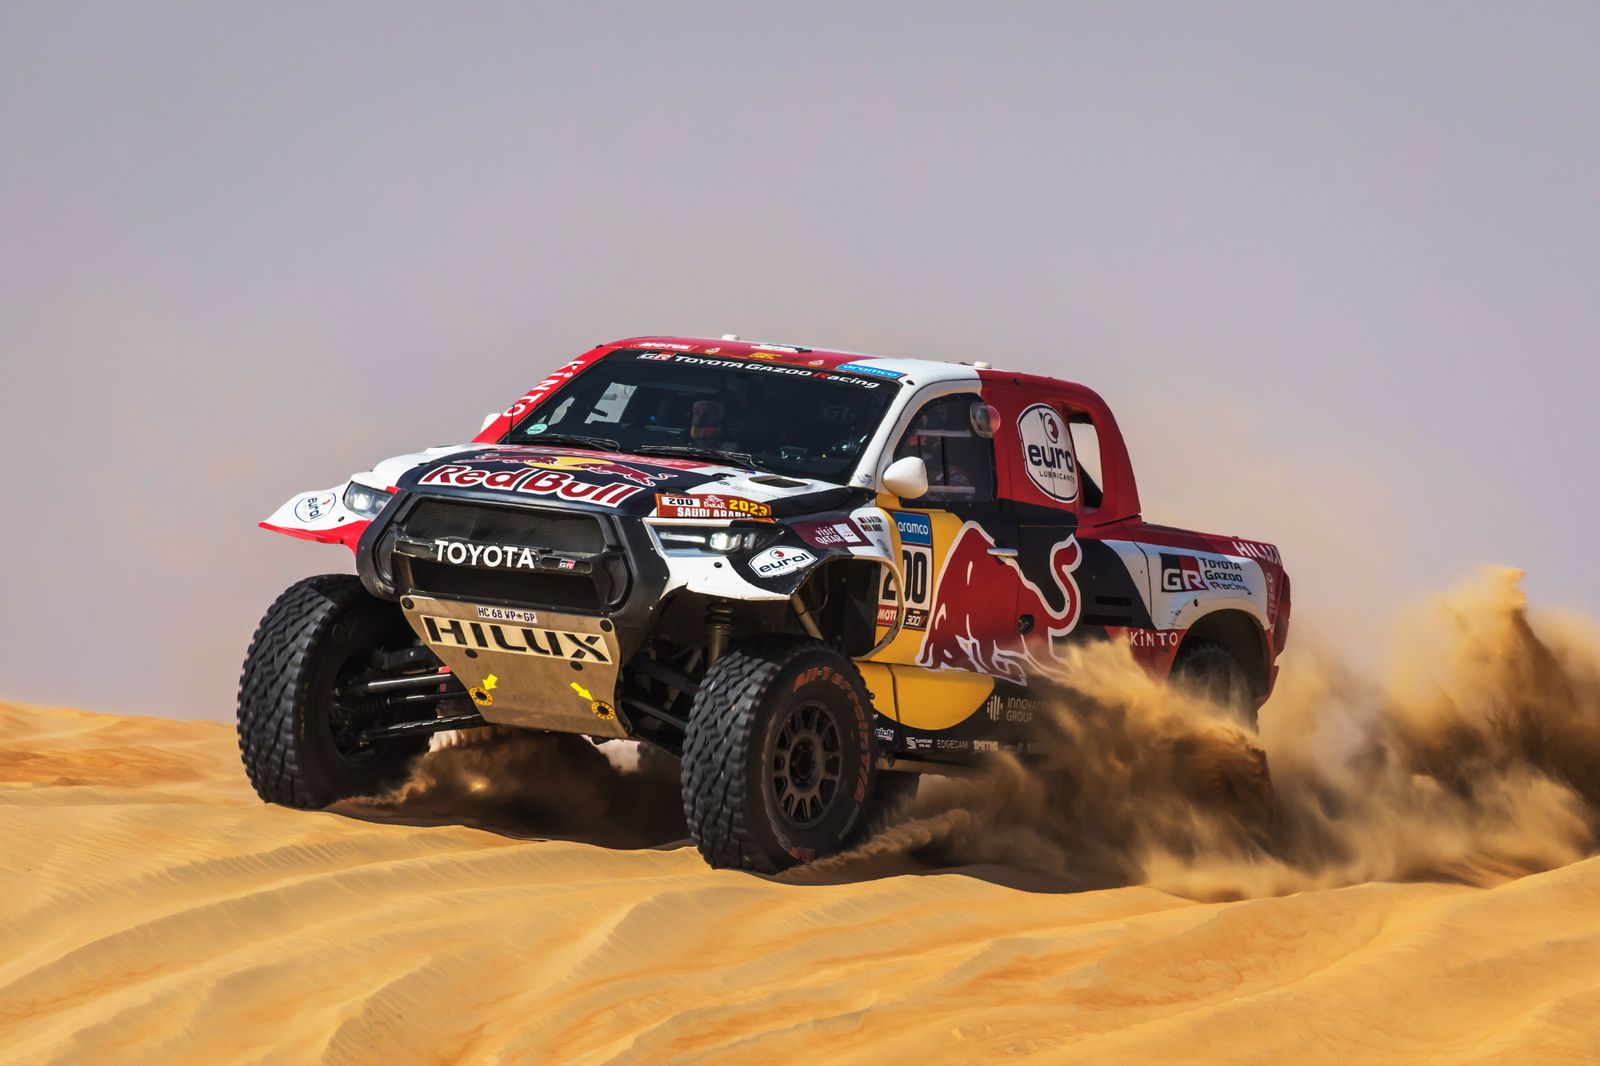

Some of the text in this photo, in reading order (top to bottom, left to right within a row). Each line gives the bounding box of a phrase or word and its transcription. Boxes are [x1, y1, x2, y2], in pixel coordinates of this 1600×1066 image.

[639, 352, 673, 360] GR
[675, 355, 744, 368] TOYOTA
[745, 363, 812, 376] GAZOO
[812, 372, 880, 389] Racing
[843, 364, 899, 377] aramco
[1028, 444, 1074, 473] euro
[421, 466, 644, 505] Red Bull
[308, 497, 323, 519] eurol
[668, 497, 694, 506] 200
[729, 499, 768, 516] 2023
[677, 507, 709, 517] SAUDI
[815, 526, 837, 537] visit
[898, 521, 929, 535] aramco
[815, 533, 844, 545] QATAR
[434, 540, 535, 569] TOYOTA
[1233, 541, 1283, 567] HILUX
[759, 553, 810, 573] eurol
[1201, 557, 1243, 571] TOYOTA
[1164, 568, 1206, 590] GR
[1204, 570, 1243, 583] GAZOO
[1211, 581, 1252, 595] Racing
[477, 607, 535, 622] HC 68 WP GP
[423, 617, 609, 662] HILUX
[1006, 710, 1033, 723] GROUP
[937, 739, 968, 750] EDGECAM
